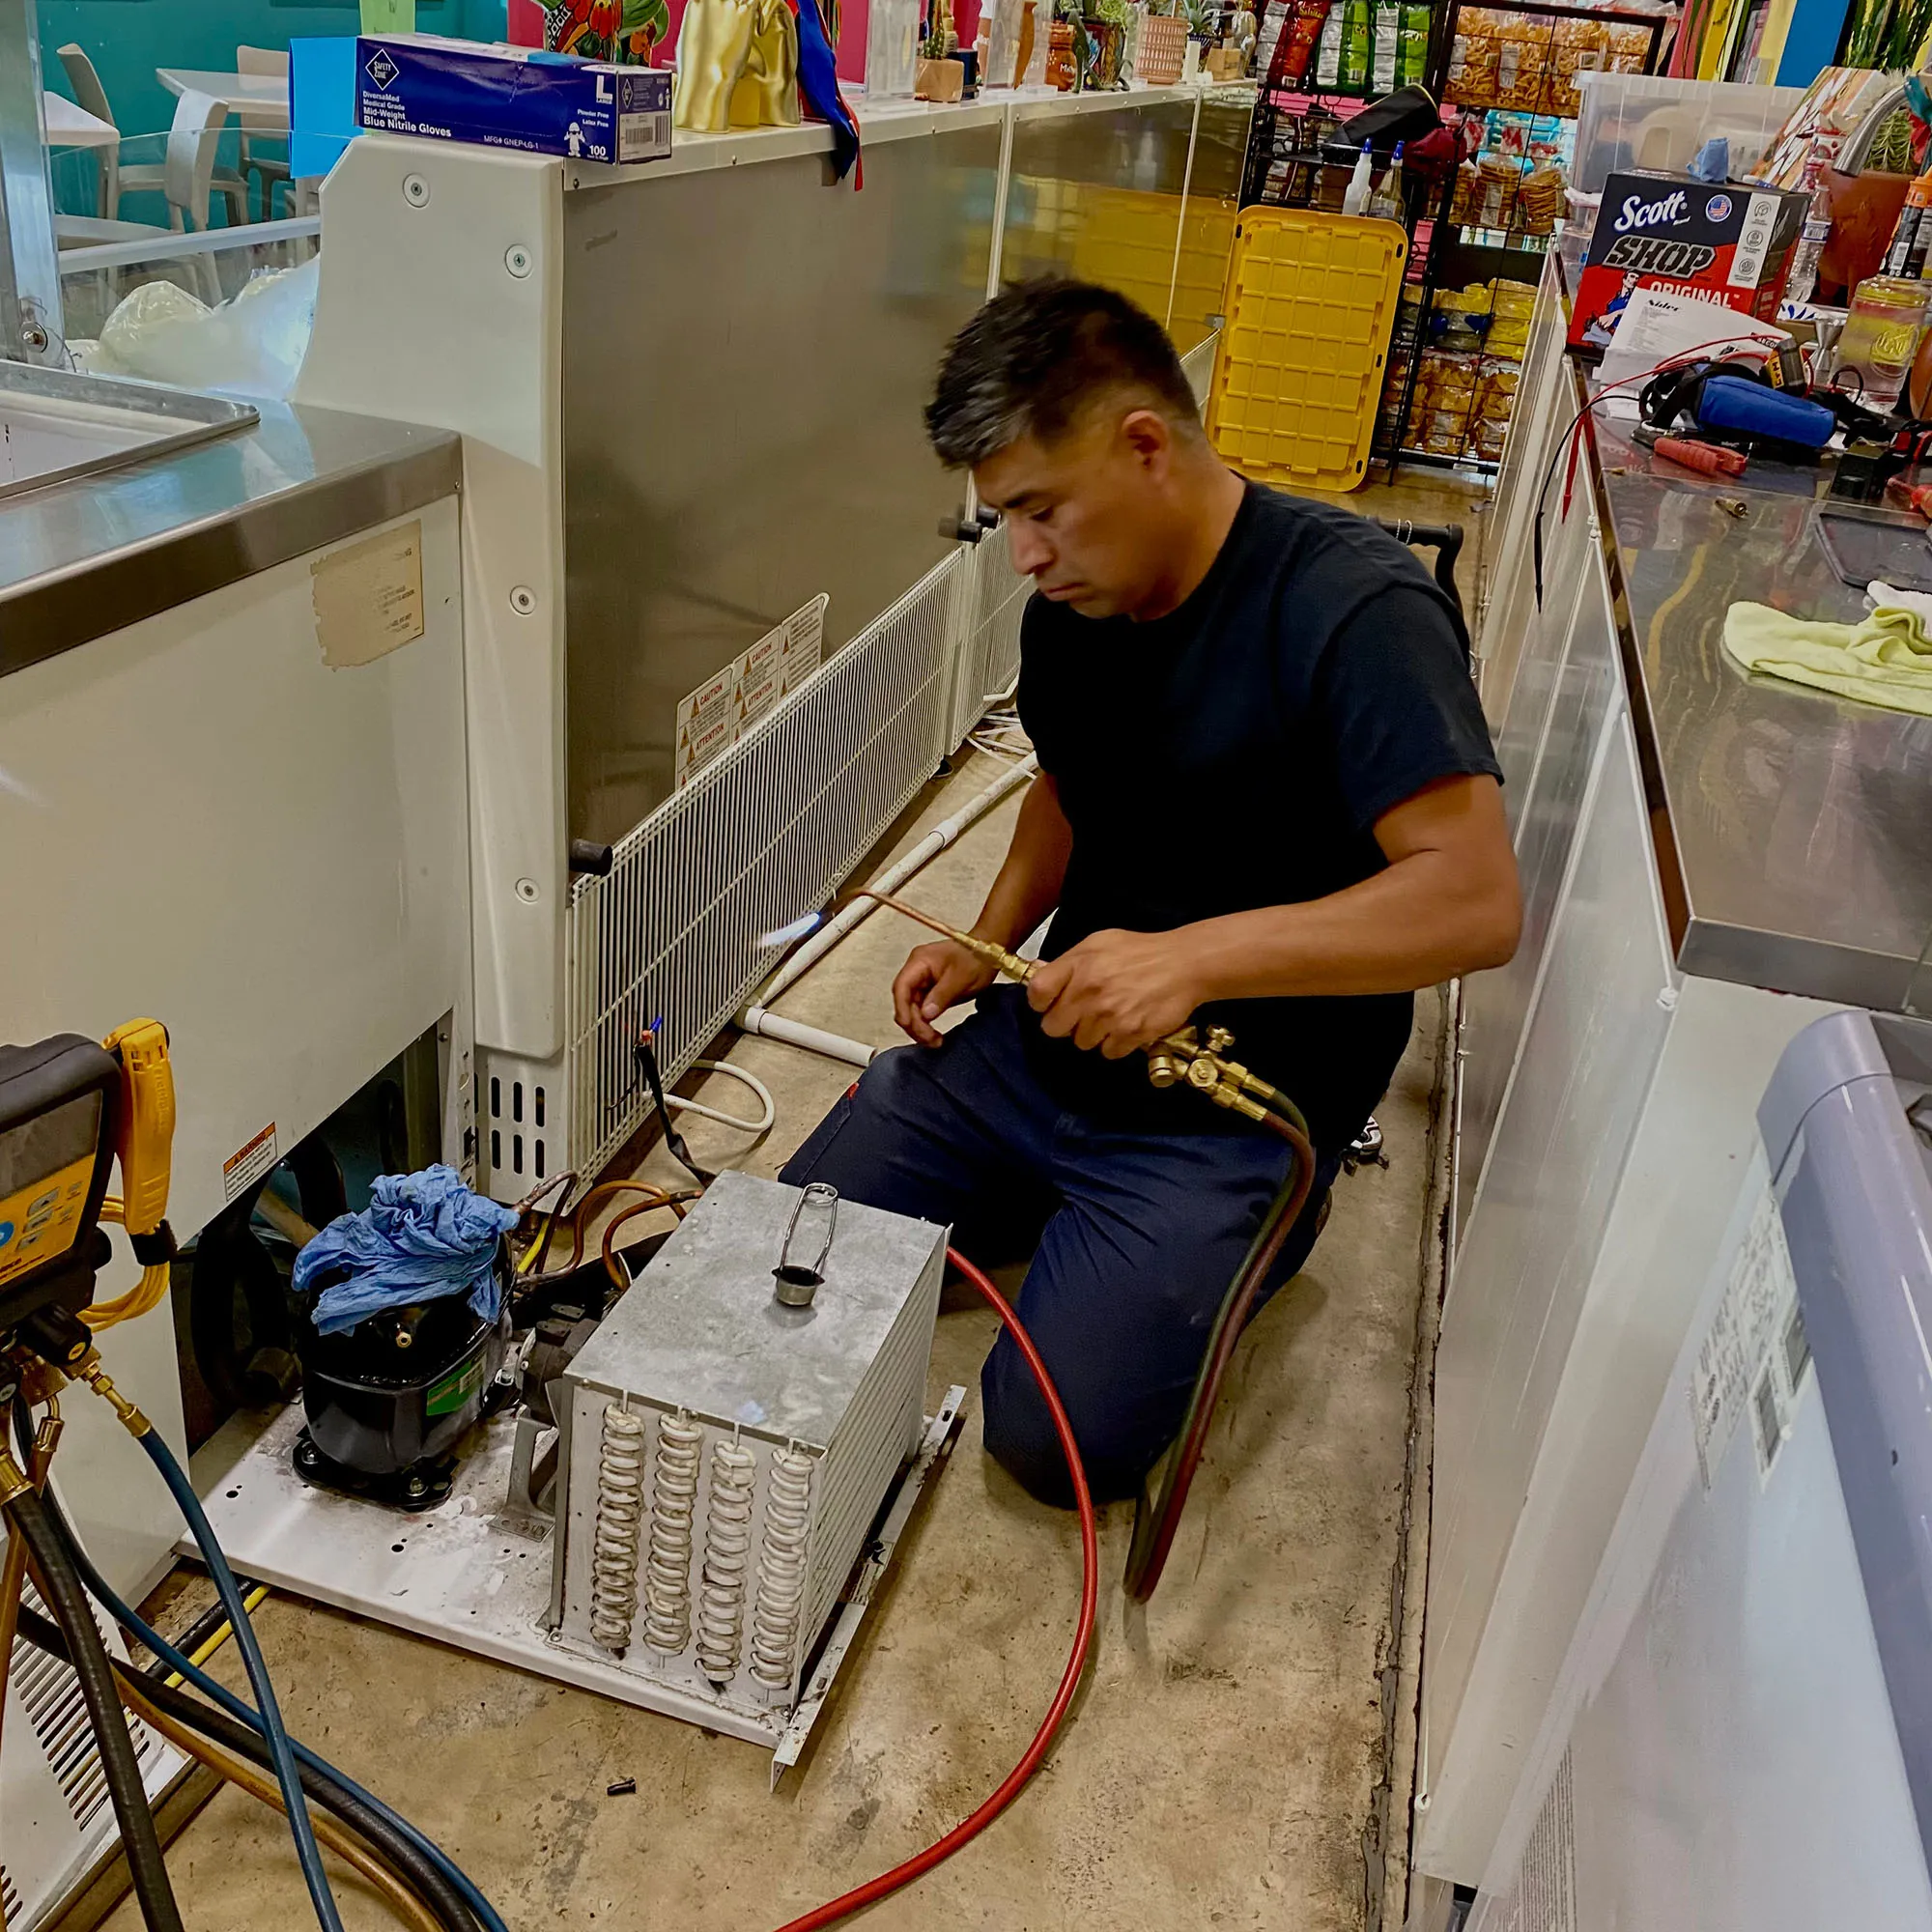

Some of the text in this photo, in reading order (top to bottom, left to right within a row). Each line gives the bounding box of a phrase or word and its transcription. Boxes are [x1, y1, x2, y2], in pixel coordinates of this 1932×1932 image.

[373, 60, 391, 71] SAFETY
[596, 74, 613, 99] L
[362, 99, 406, 111] Medical Grade
[362, 106, 406, 122] Mid-Weight
[363, 115, 452, 137] Blue Nitrile Gloves
[588, 145, 607, 156] 100
[1603, 235, 1716, 278] SHOP
[752, 642, 773, 664] CAUTION
[699, 681, 724, 705] CAUTION
[747, 681, 773, 707] ATTENTION
[696, 724, 724, 751] ATTENTION
[240, 1131, 267, 1158] WARNING
